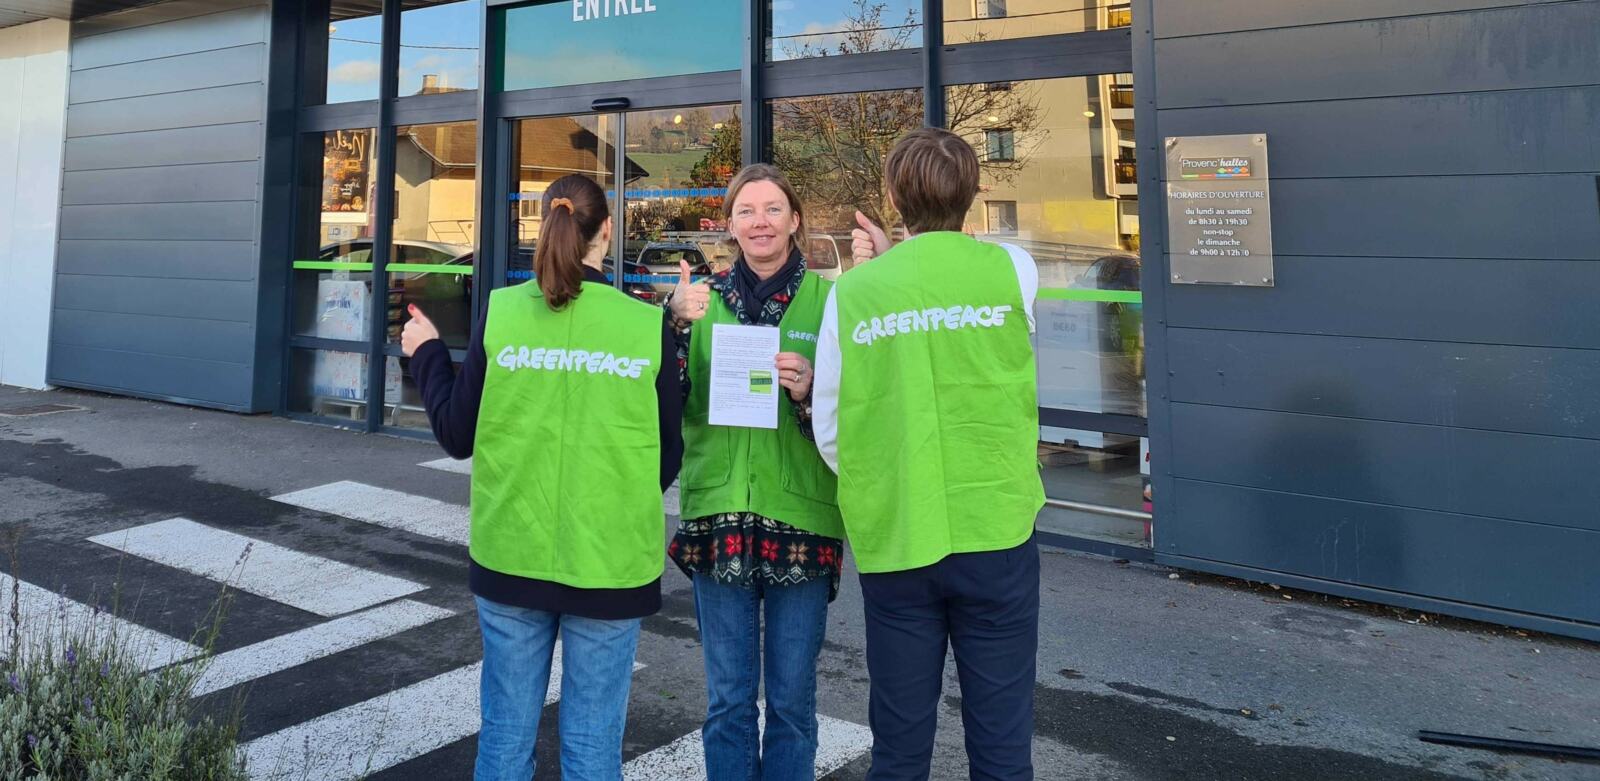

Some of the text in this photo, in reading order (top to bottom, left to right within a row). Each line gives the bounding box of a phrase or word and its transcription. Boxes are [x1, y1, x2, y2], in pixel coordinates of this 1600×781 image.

[1170, 190, 1265, 199] HORAIRES D'OUVERTURE
[1196, 207, 1215, 215] lundi
[1226, 207, 1253, 215] samedi
[1205, 238, 1241, 246] dimanche
[1189, 248, 1199, 256] de
[1200, 248, 1218, 256] 9h00
[852, 305, 1012, 346] GREENPEACE
[496, 345, 651, 379] GREENPEACE
